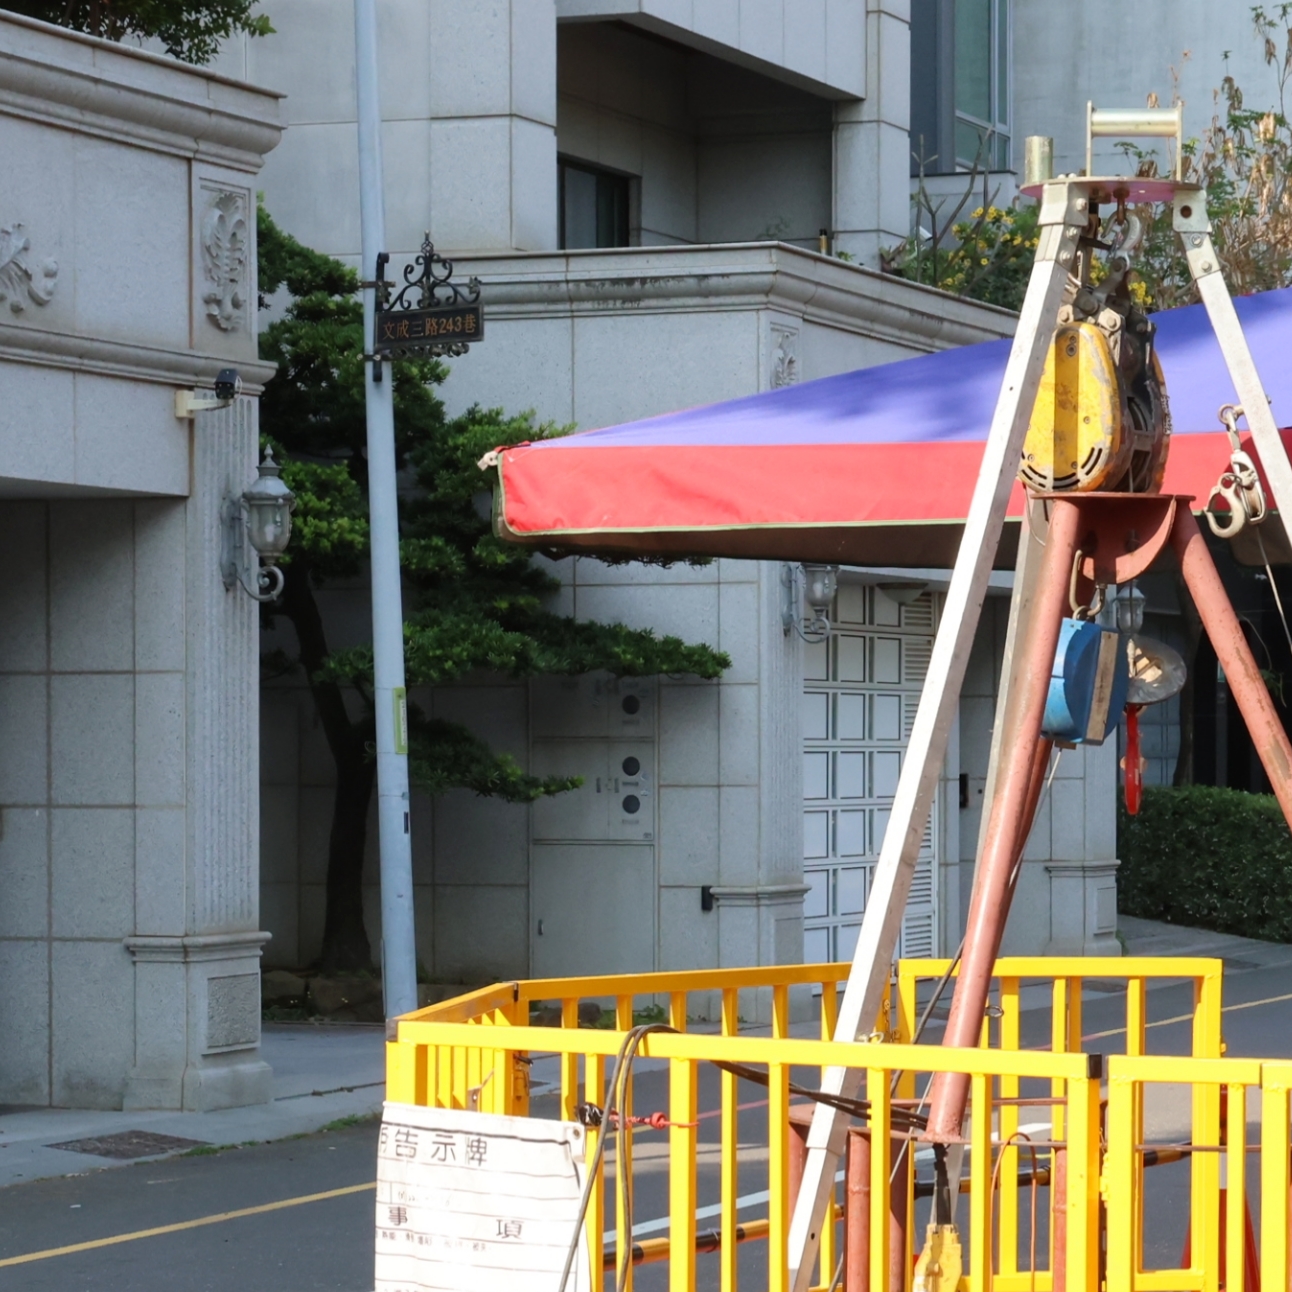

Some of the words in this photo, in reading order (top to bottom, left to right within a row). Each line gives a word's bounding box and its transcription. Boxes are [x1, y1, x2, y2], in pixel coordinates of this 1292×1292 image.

[383, 313, 476, 340] 文成三路243巷
[381, 1127, 488, 1166] 告示牌
[388, 1206, 408, 1227] 事
[496, 1218, 524, 1240] 項
